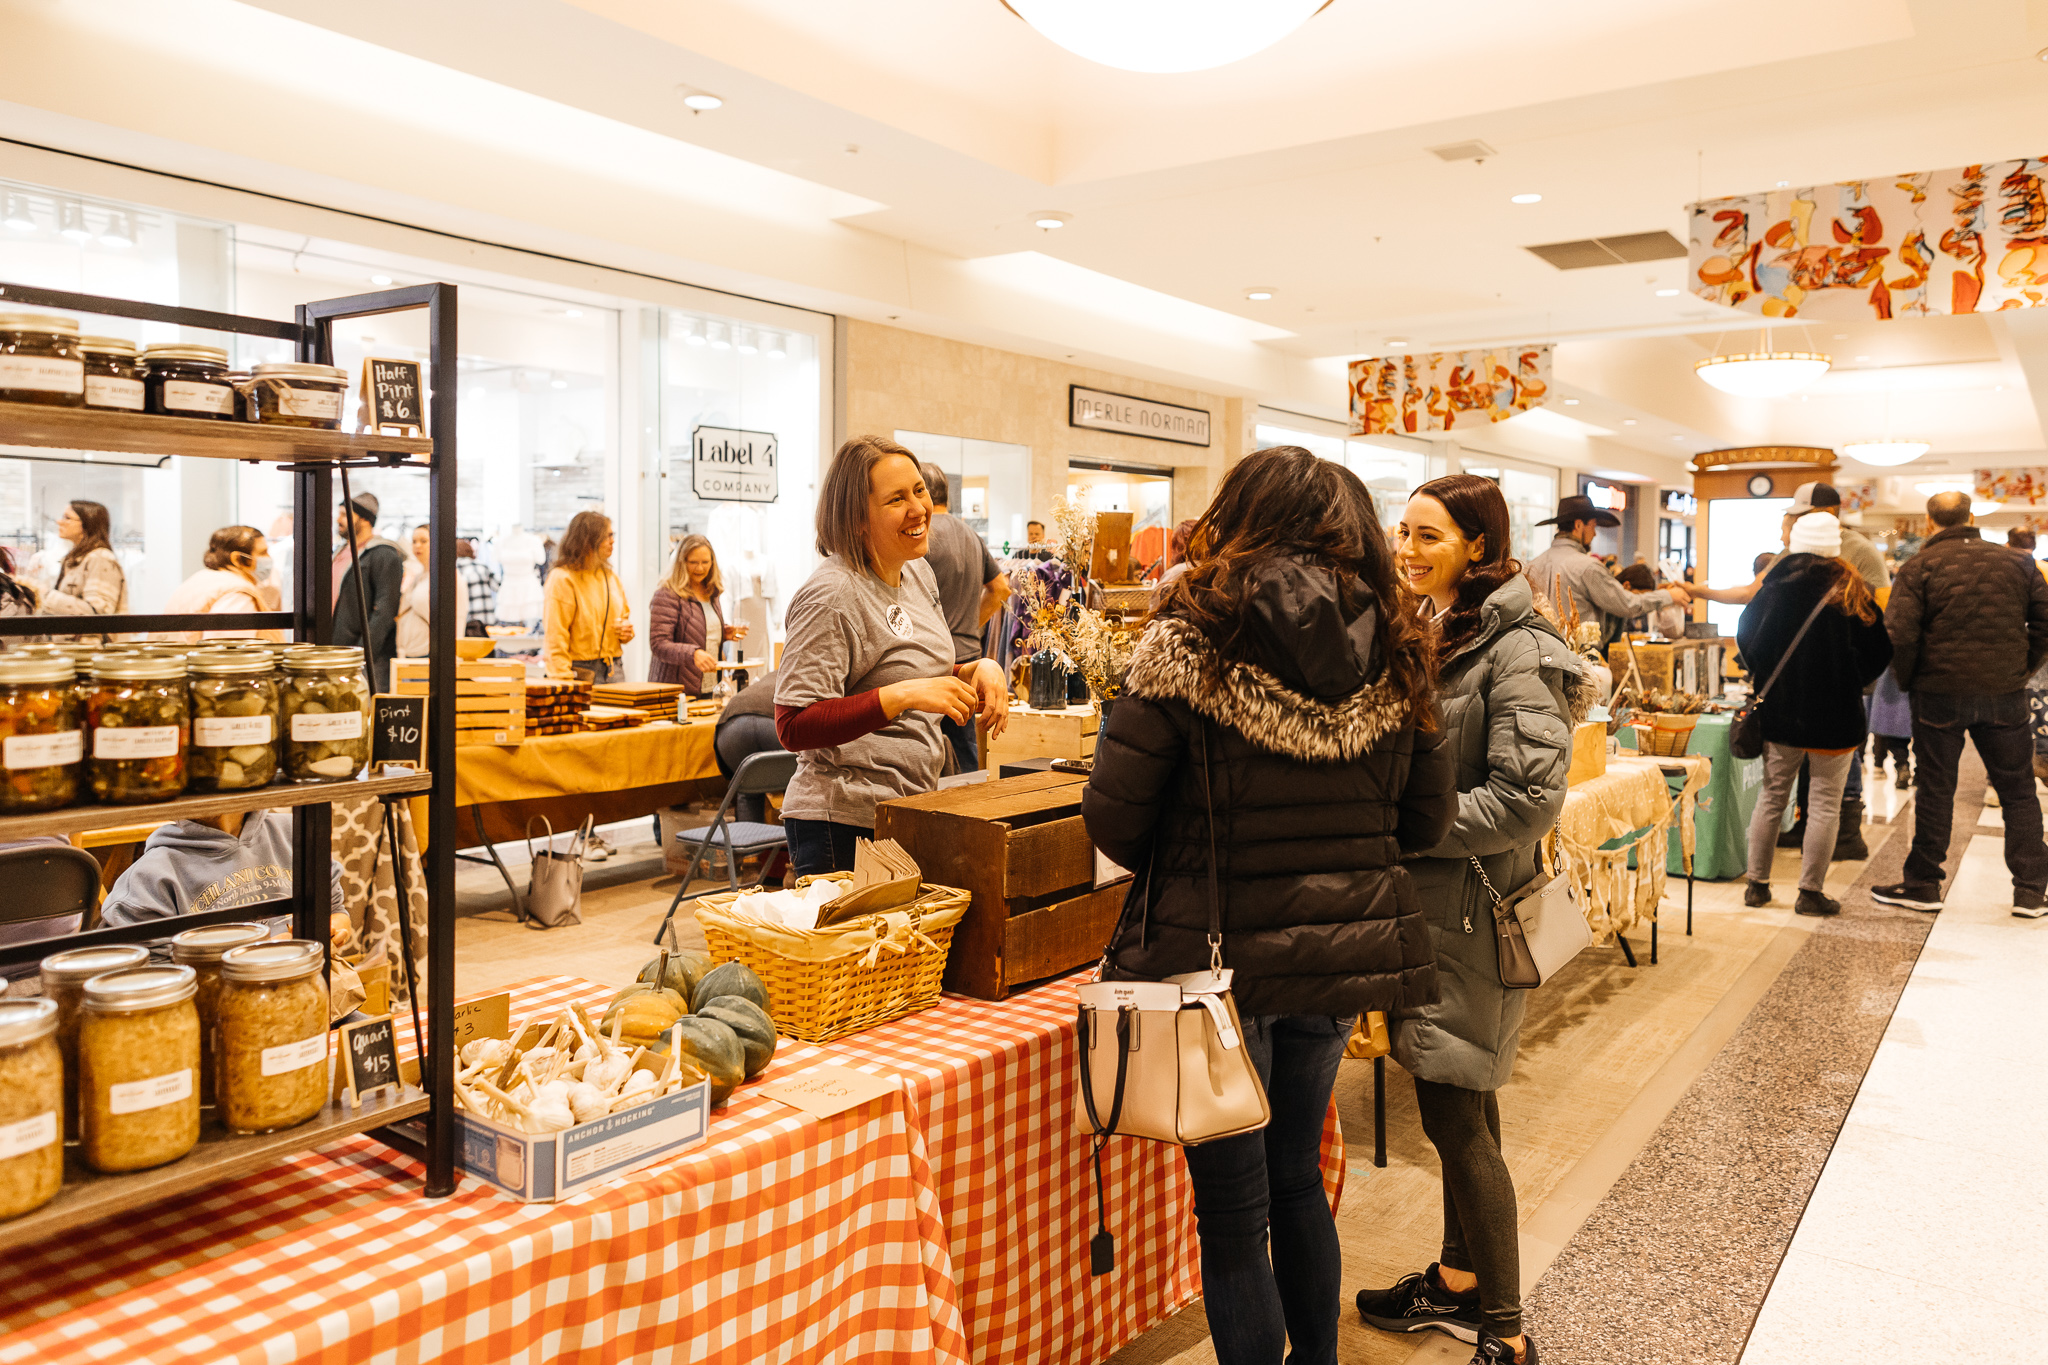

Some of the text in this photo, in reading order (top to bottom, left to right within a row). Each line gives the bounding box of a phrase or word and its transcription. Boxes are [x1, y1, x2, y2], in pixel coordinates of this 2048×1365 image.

[375, 364, 408, 382] Half
[377, 382, 414, 399] Pint
[1076, 398, 1206, 436] MERLE NORMAN
[699, 438, 774, 467] Label 4
[1703, 448, 1824, 465] DIRECTORY
[703, 479, 770, 494] COMPANY
[387, 725, 419, 743] $10
[454, 1006, 482, 1020] arlic
[363, 1054, 391, 1073] $15
[567, 1107, 654, 1143] ANCHOR HOCKING
